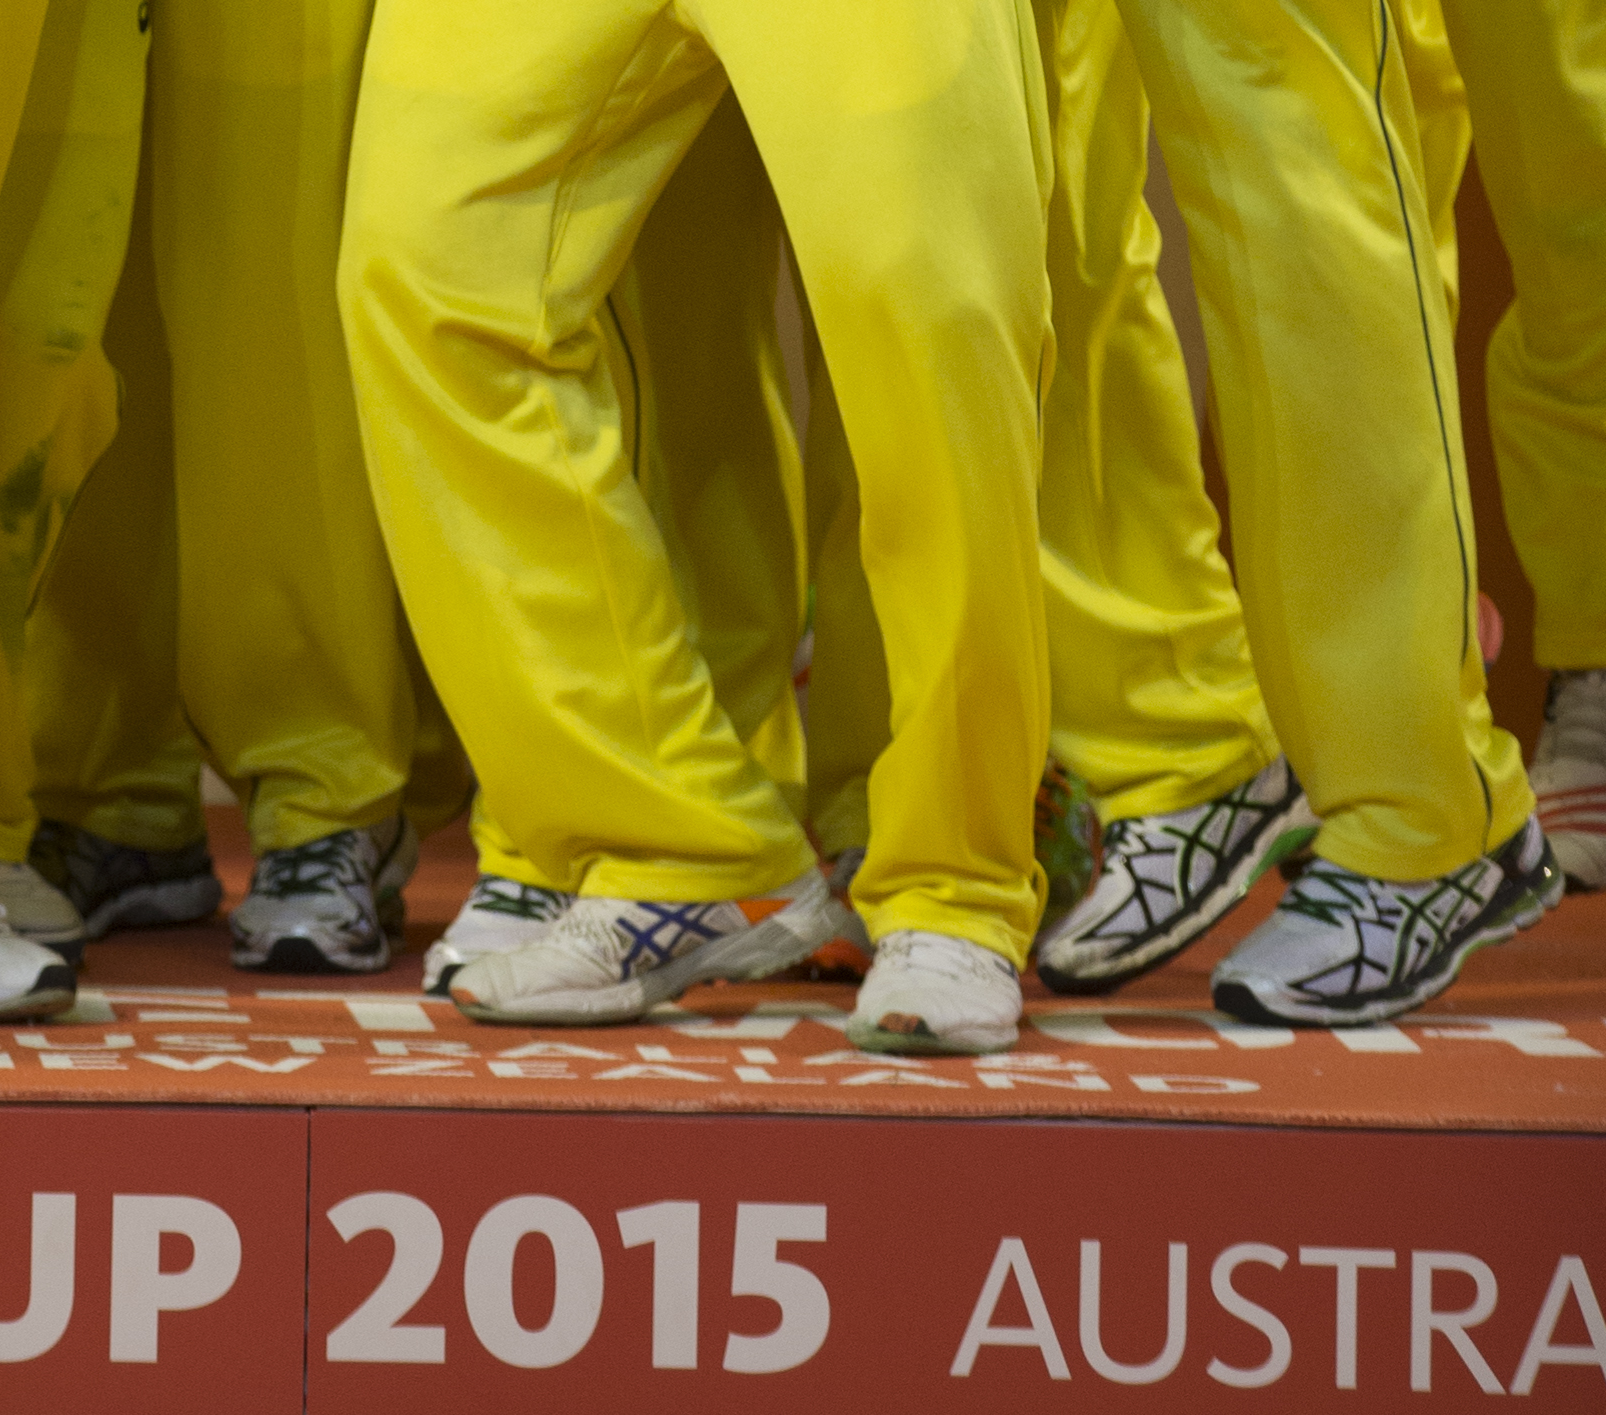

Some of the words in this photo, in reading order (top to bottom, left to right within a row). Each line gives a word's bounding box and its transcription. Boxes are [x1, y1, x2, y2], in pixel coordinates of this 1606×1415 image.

[363, 1057, 1262, 1094] ZEALAND
[325, 1190, 832, 1375] 2015
[949, 1236, 1606, 1395] AUSTRA
